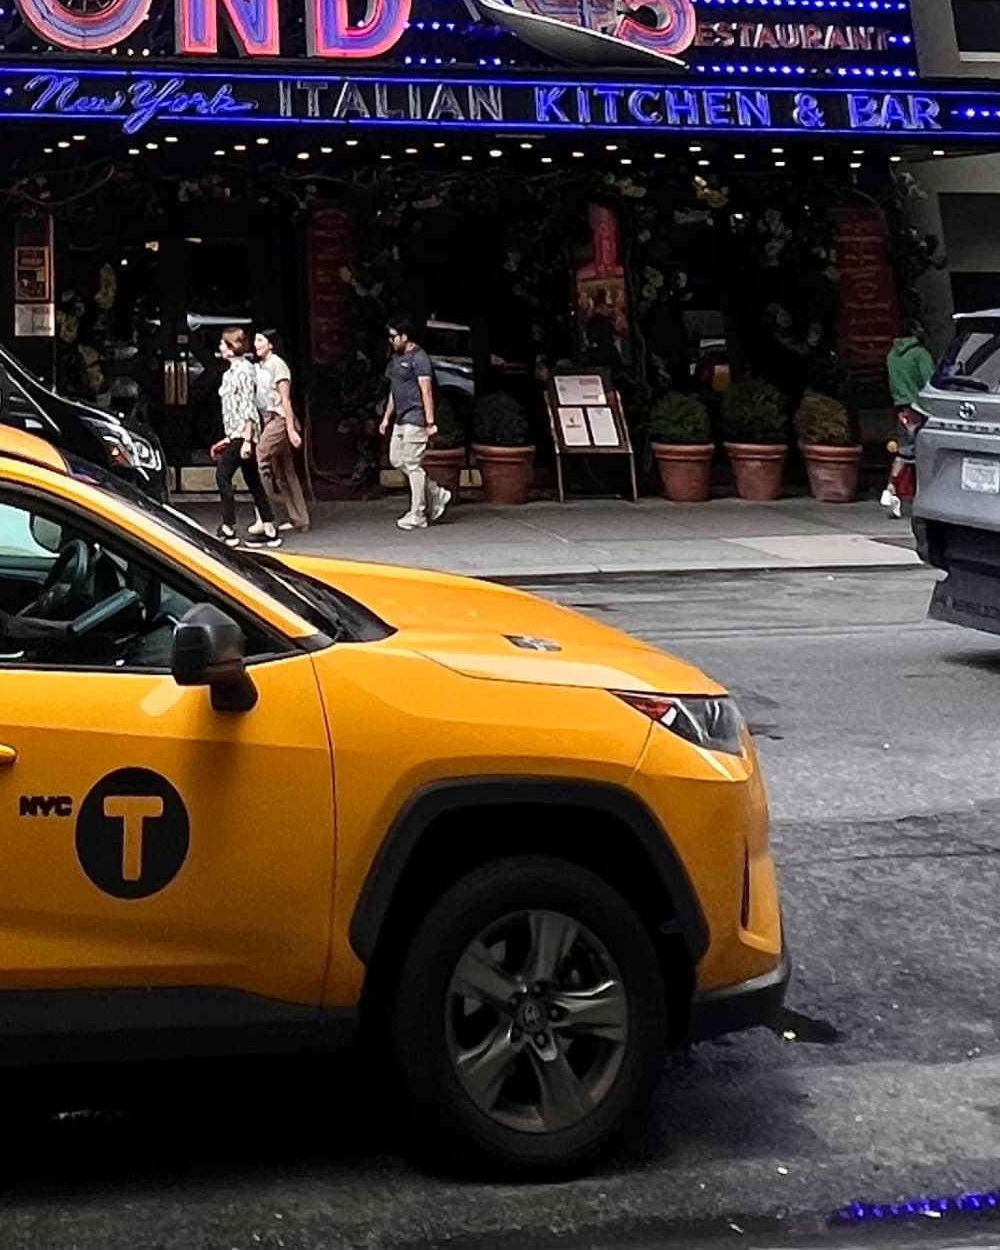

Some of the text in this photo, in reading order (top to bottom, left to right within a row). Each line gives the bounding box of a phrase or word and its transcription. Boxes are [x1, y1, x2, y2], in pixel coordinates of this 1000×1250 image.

[694, 21, 891, 51] ESTAURANT
[24, 74, 943, 134] New York ITALIAN KITCHEN & BAR
[18, 795, 164, 881] NYC T
